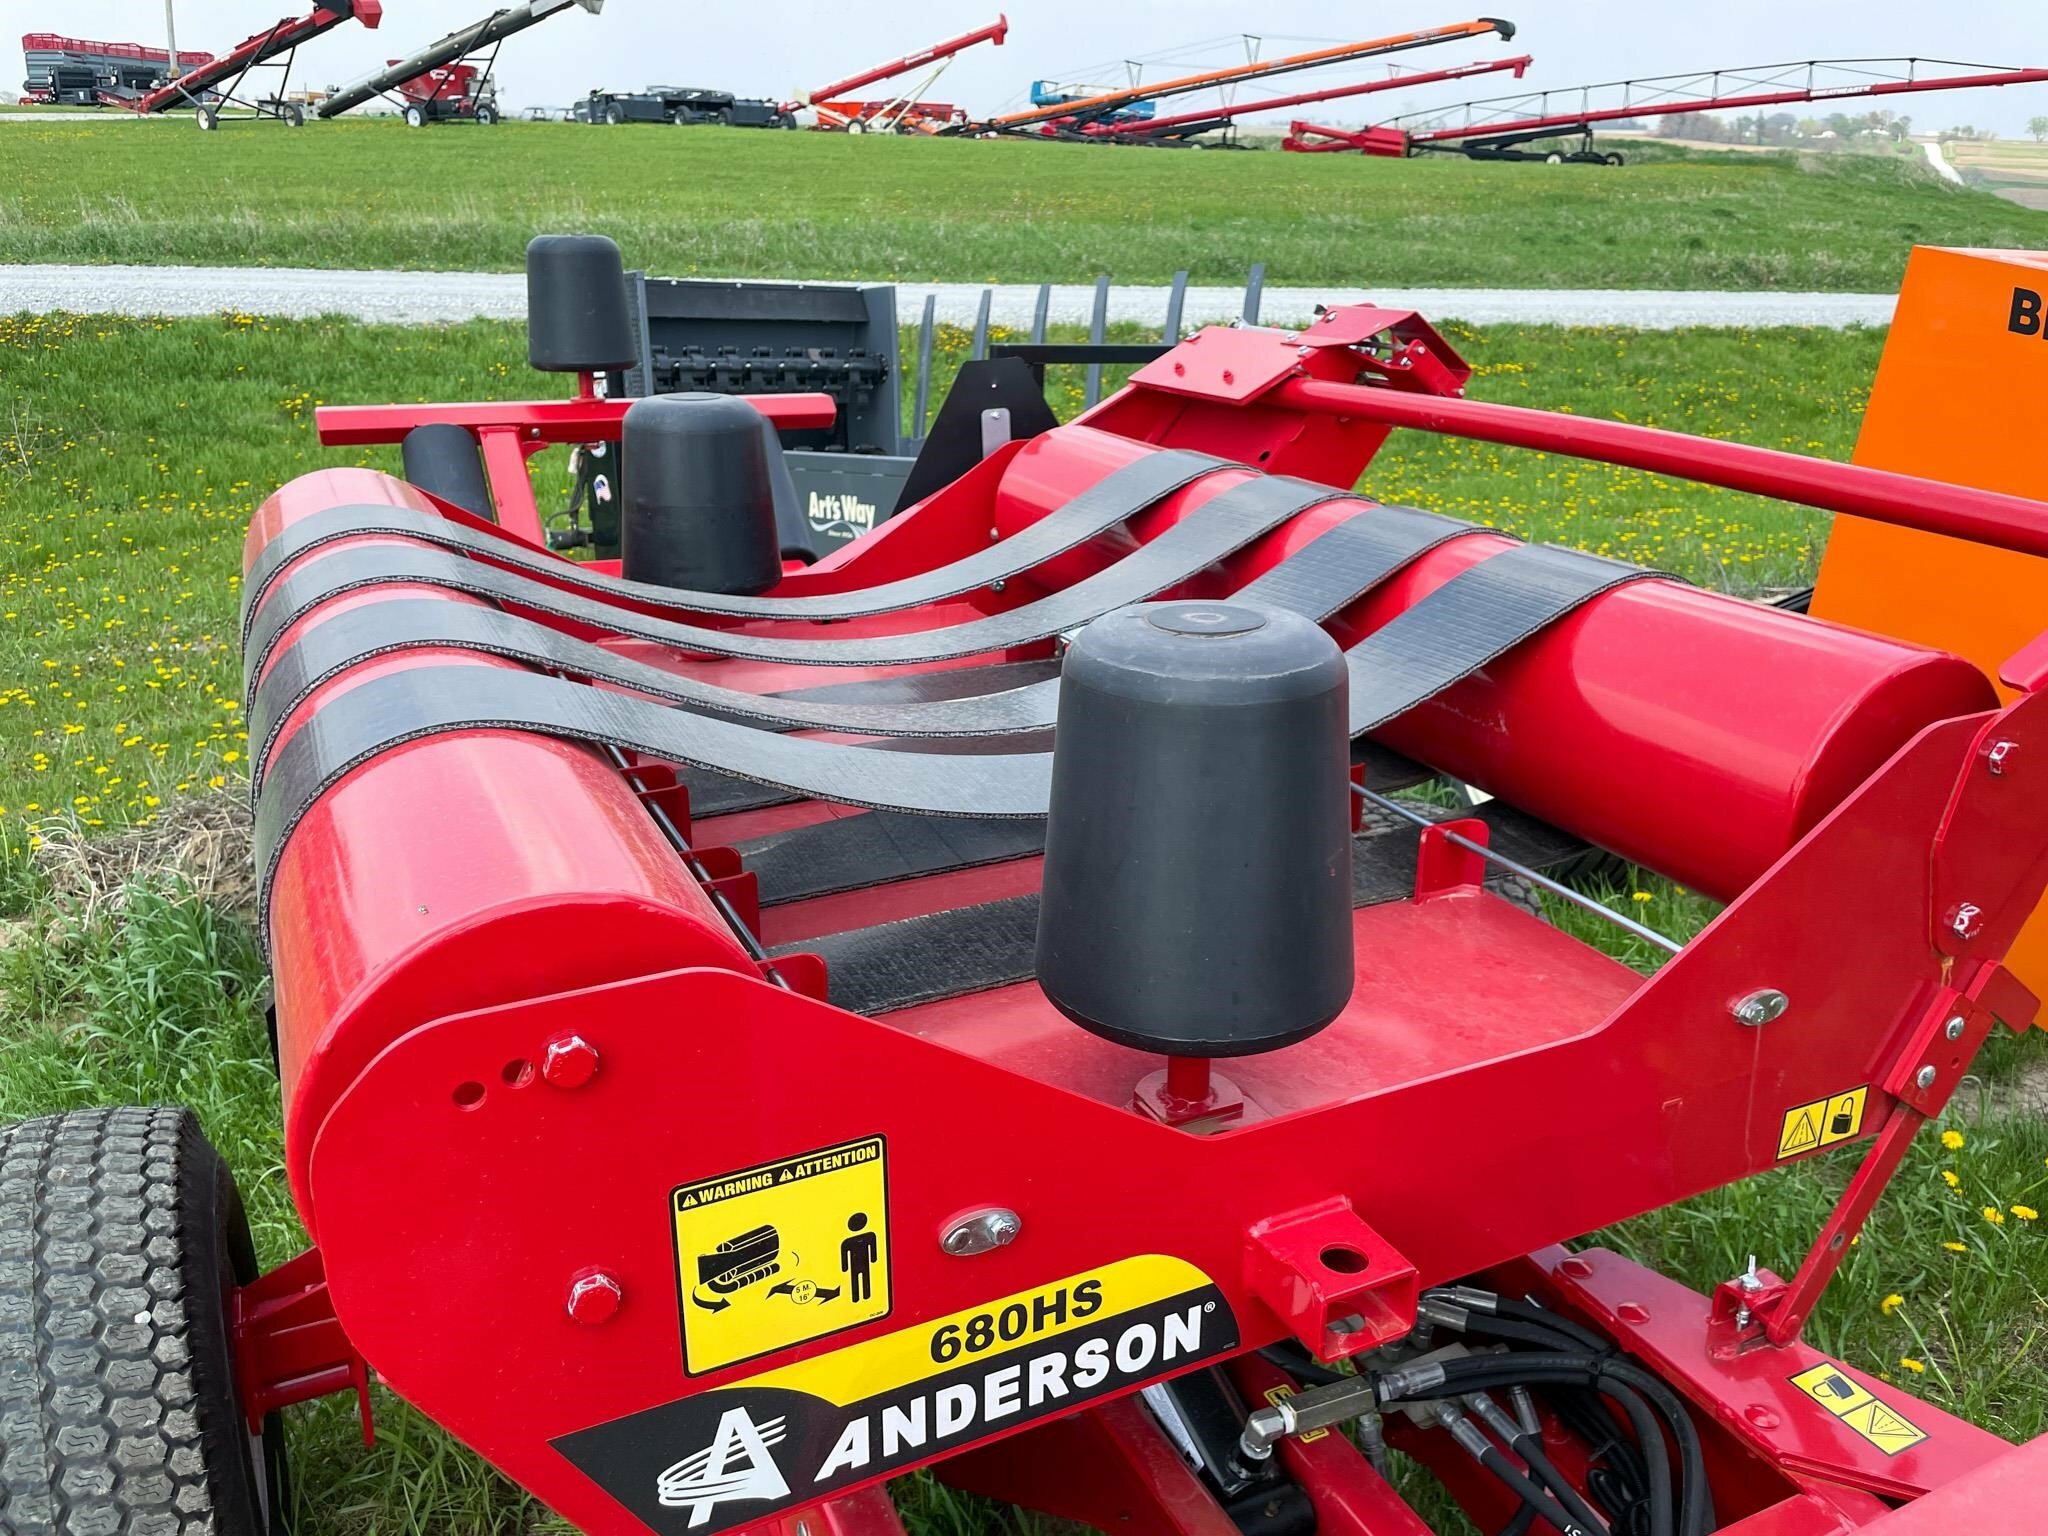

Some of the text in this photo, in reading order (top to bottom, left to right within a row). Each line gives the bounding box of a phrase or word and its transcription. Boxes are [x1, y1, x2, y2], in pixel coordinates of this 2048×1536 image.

[2008, 286, 2048, 340] B
[808, 491, 876, 530] Art's Way
[698, 1144, 876, 1204] WARNING ATTENTION
[795, 1286, 801, 1294] 5
[930, 1279, 1103, 1364] 680HS
